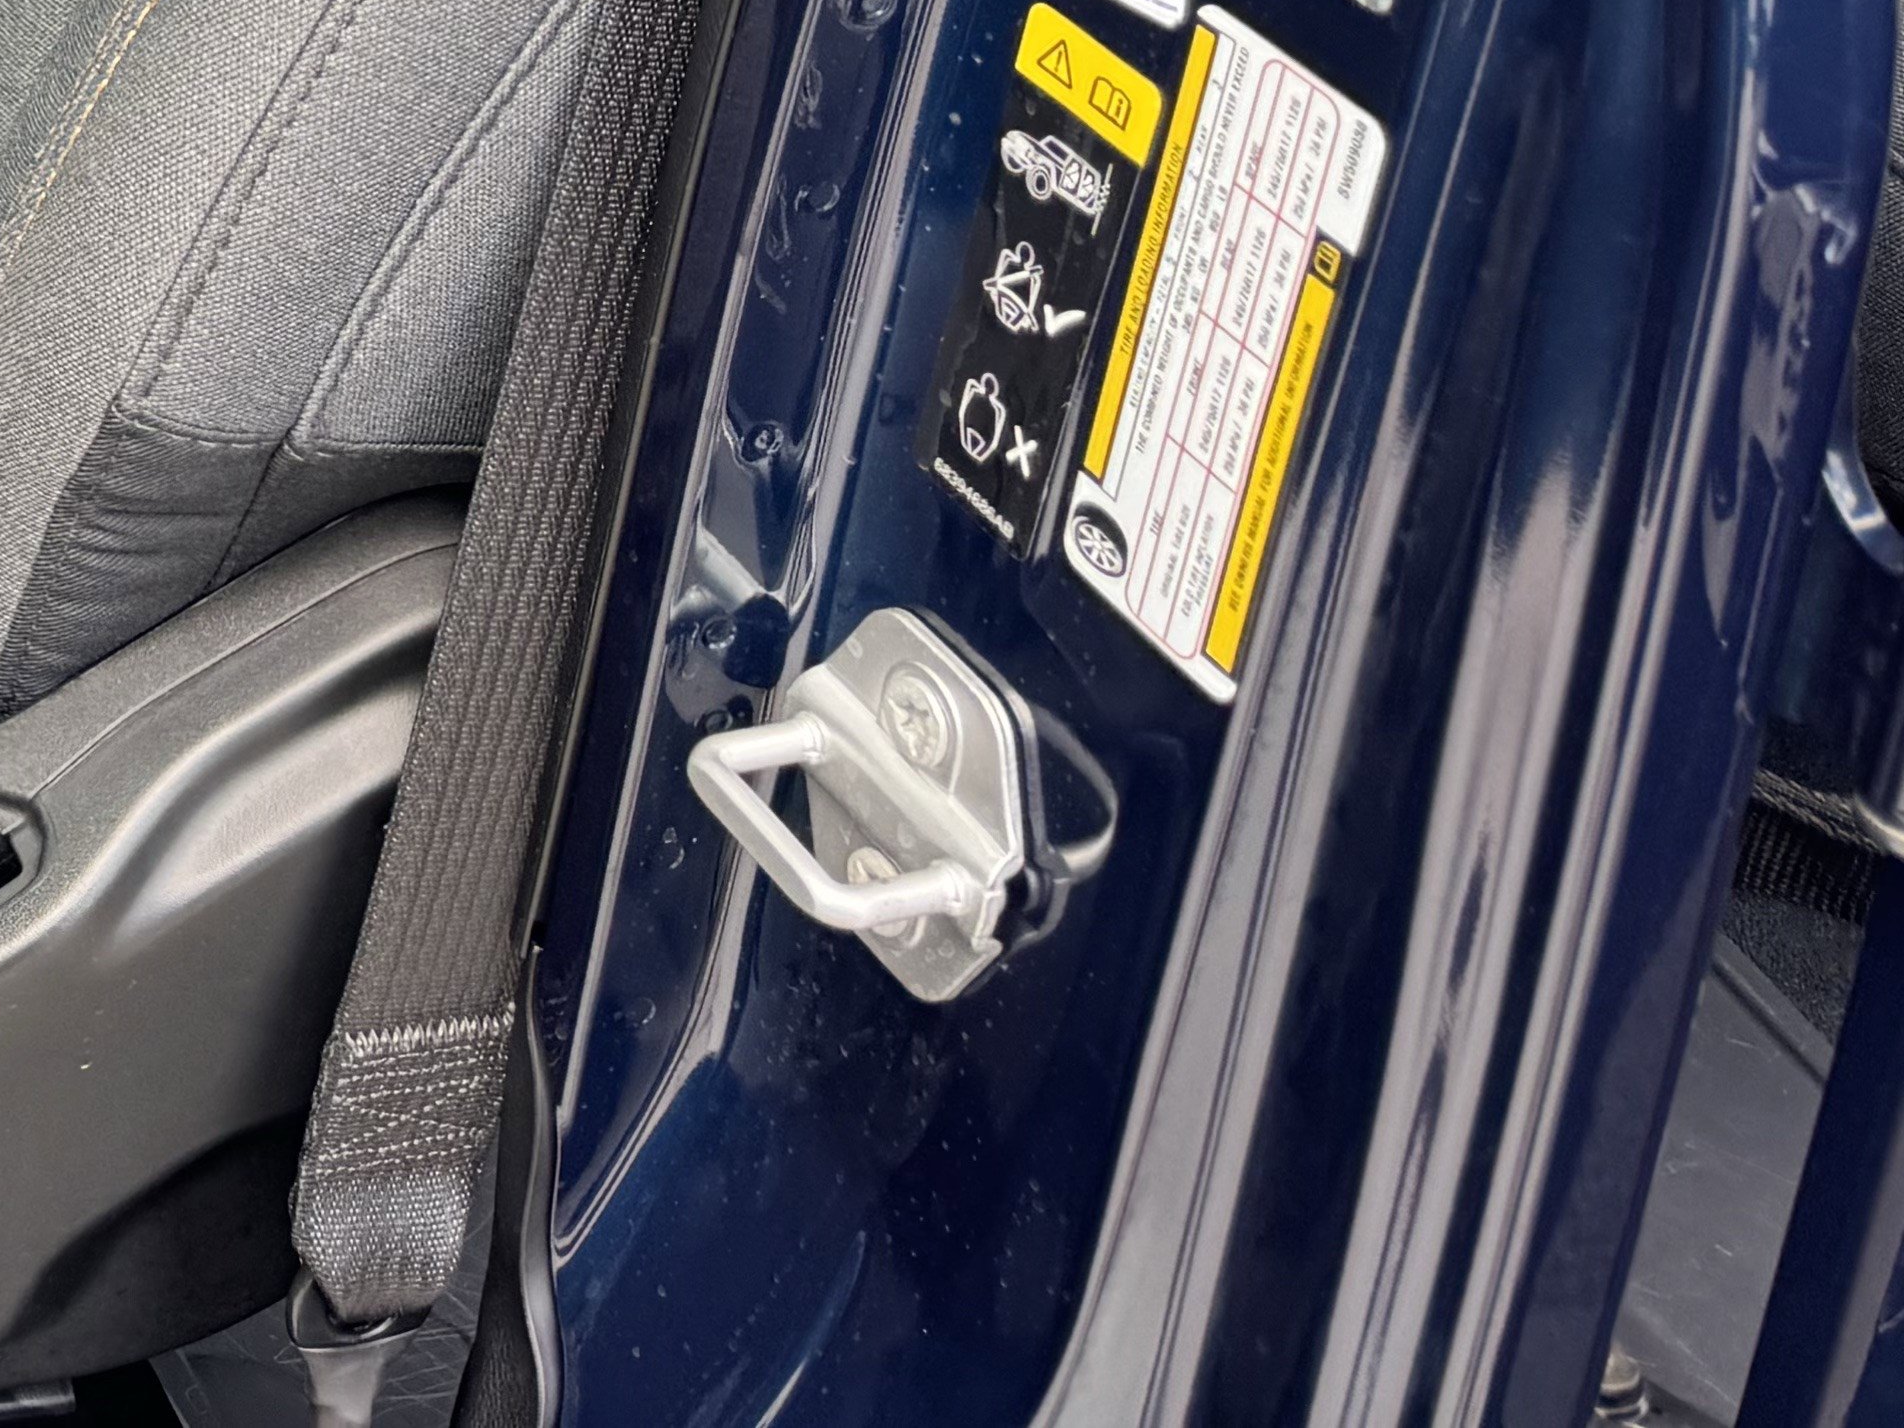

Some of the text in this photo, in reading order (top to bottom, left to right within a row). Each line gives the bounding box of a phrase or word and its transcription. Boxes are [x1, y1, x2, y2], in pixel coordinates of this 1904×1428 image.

[1119, 139, 1182, 357] TIRE AND LOADING INFORMATION
[1134, 44, 1250, 456] THE COMBINED WEIGHT OF OCCUPANTS AND CARGO SHOULD NEVER EXCEED
[1284, 319, 1313, 400] INFORMATION
[1265, 400, 1291, 469] ADDITIONAL
[1259, 467, 1273, 494] FOR
